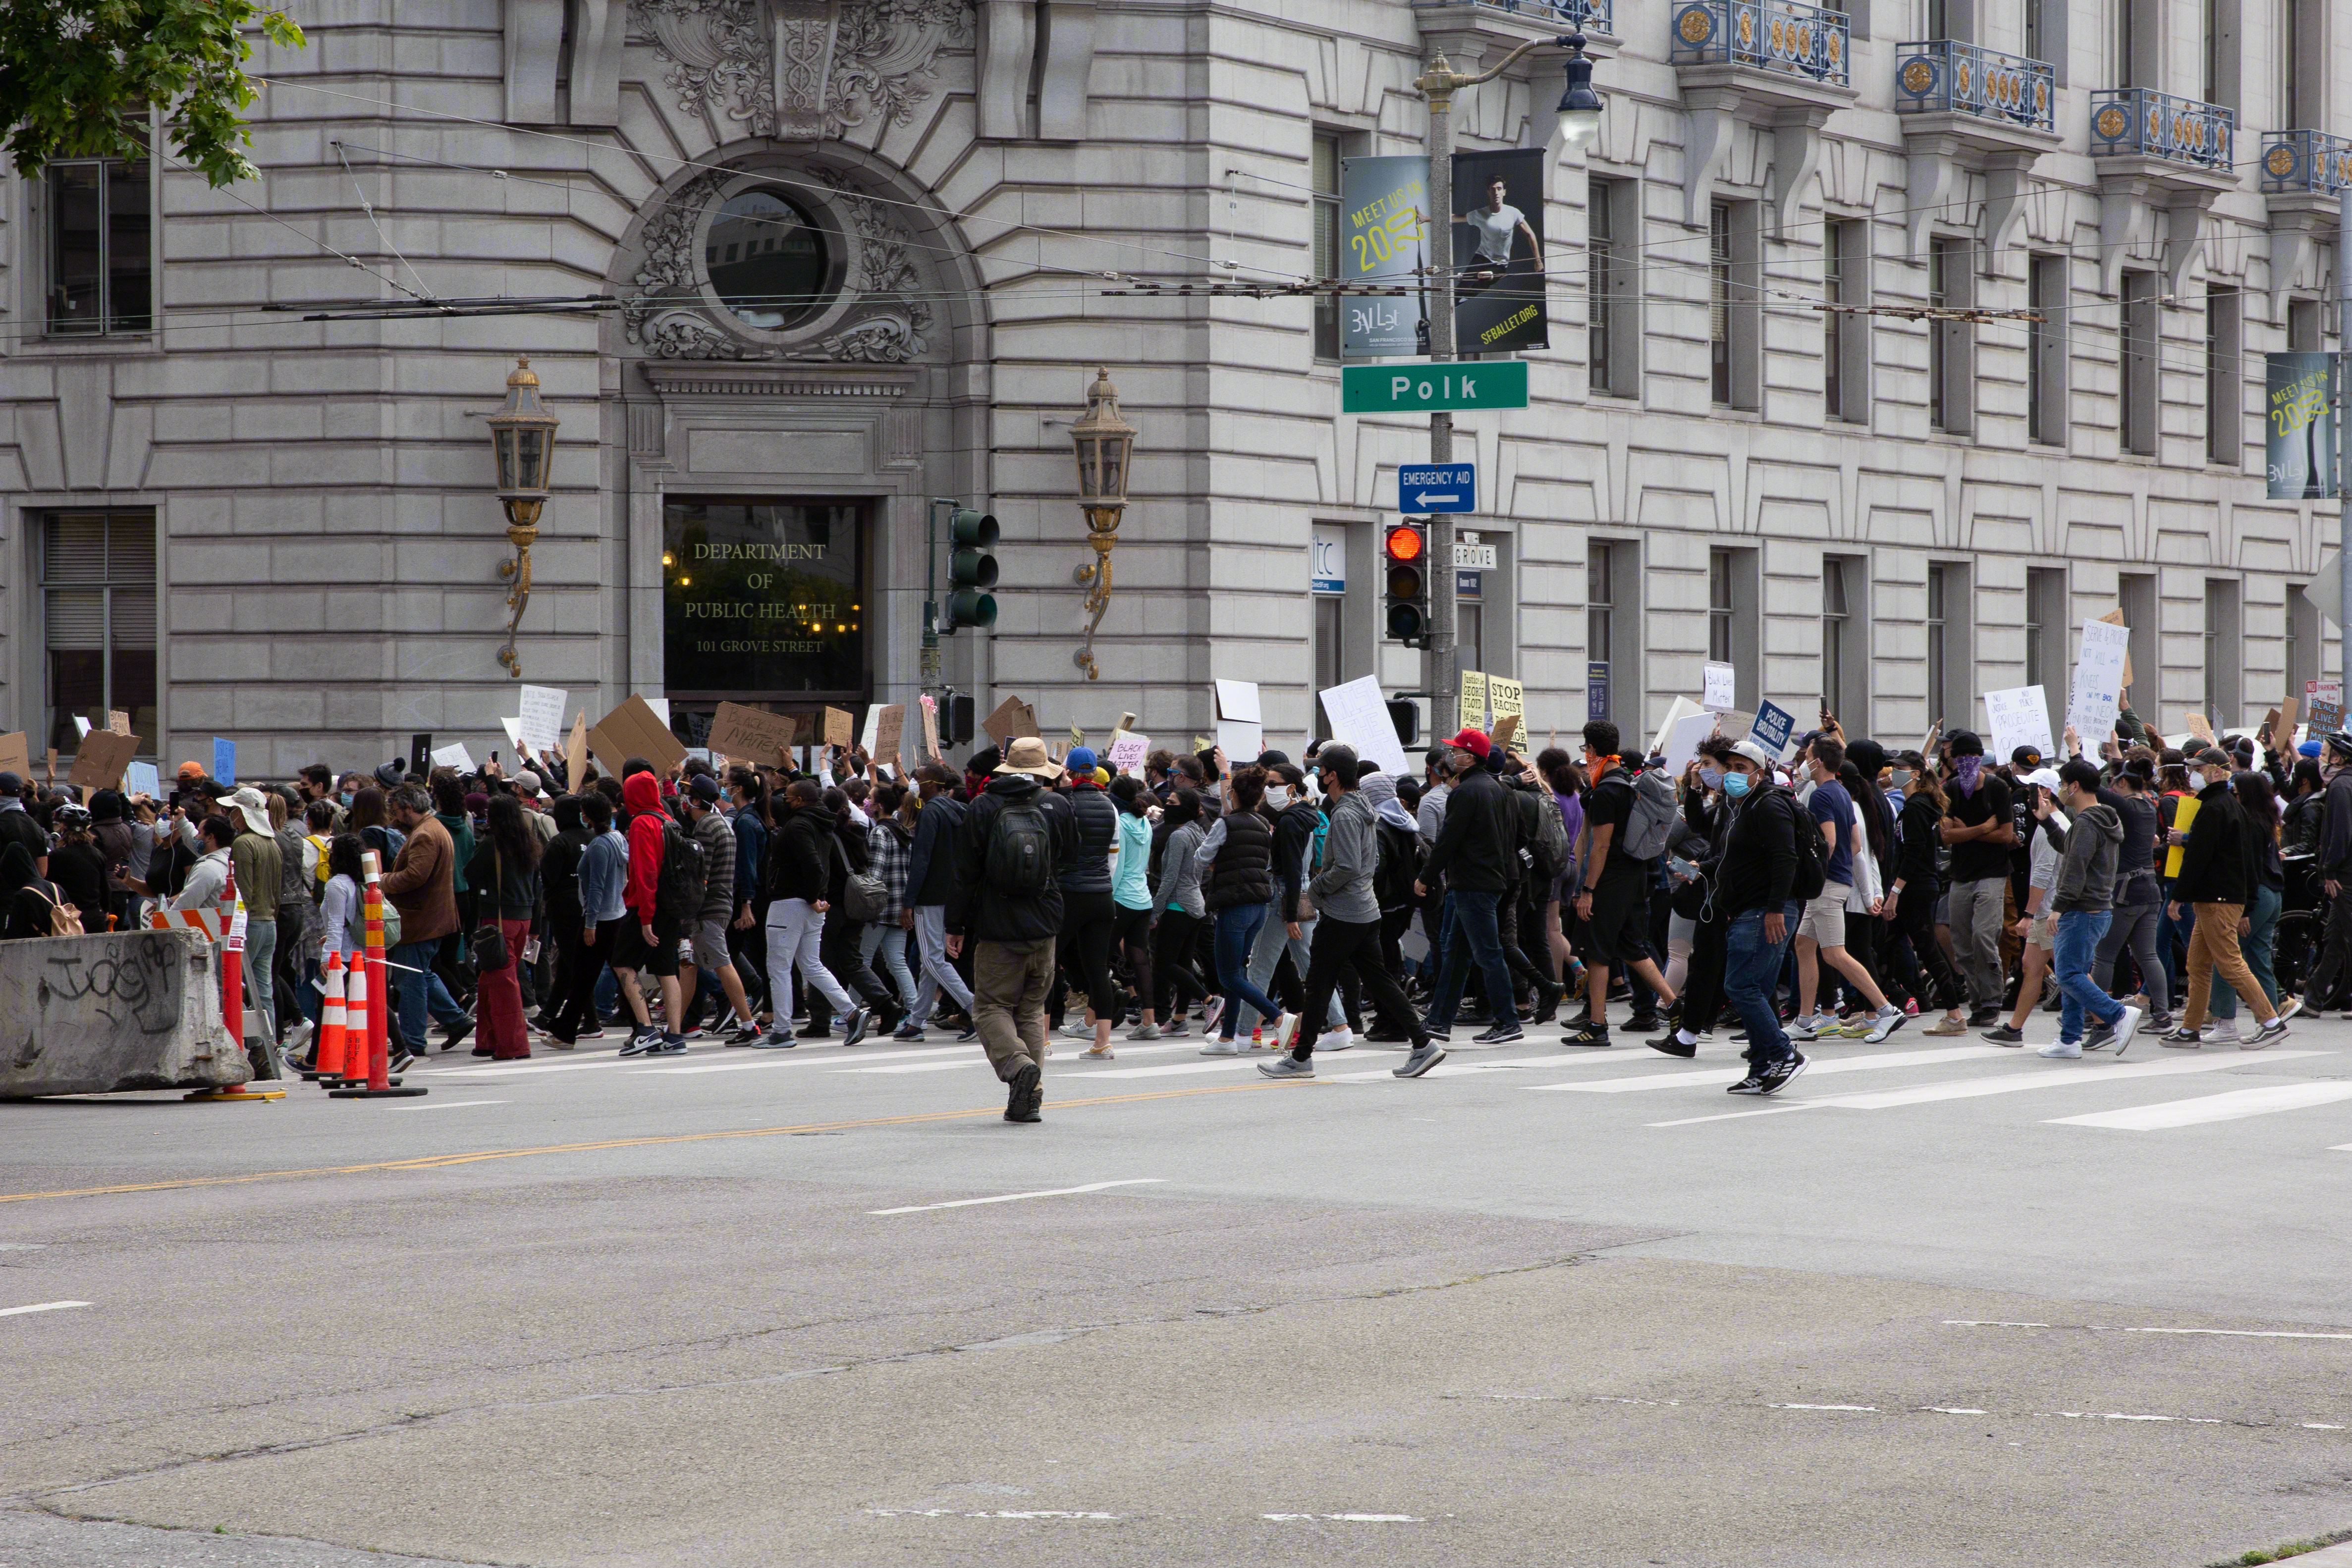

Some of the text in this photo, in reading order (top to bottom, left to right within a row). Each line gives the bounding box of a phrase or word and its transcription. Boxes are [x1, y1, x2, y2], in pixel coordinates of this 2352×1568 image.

[1351, 178, 1423, 228] MEET US IN
[1481, 305, 1538, 345] SFBALLET.ORG
[1392, 375, 1477, 400] Polk
[2272, 370, 2328, 405] MEET US IN
[1403, 471, 1470, 486] EMERGENCY AID
[695, 543, 826, 559] DEPARTMENT
[1456, 548, 1490, 565] GROVE
[747, 573, 773, 589] OF
[685, 603, 836, 619] PUBLIC HEALTH
[2085, 625, 2102, 642] SERVE
[2110, 629, 2129, 647] PROTECT
[697, 641, 823, 653] 101 GROVE STREET
[2082, 648, 2091, 658] NOT
[2095, 650, 2105, 665] KILL
[1464, 674, 1479, 686] Justice
[1708, 671, 1733, 686] Black Lives
[1464, 686, 1484, 698] GEORGE
[1492, 683, 1520, 700] STOP
[2307, 682, 2315, 692] NO
[1324, 679, 1382, 723] RAISE
[1713, 690, 1731, 703] Matter
[2019, 698, 2033, 707] PEACE
[2102, 694, 2113, 702] BACK
[1493, 699, 1522, 713] RACIST
[2096, 705, 2116, 720] NECK
[2313, 700, 2339, 713] BLACK
[727, 706, 789, 738] BLACK LIVES
[1996, 710, 2039, 730] PROSECUTE
[2315, 712, 2338, 724] LIVES
[1343, 712, 1385, 744] THE
[724, 726, 785, 755] MATTER
[1117, 744, 1143, 752] BLACK
